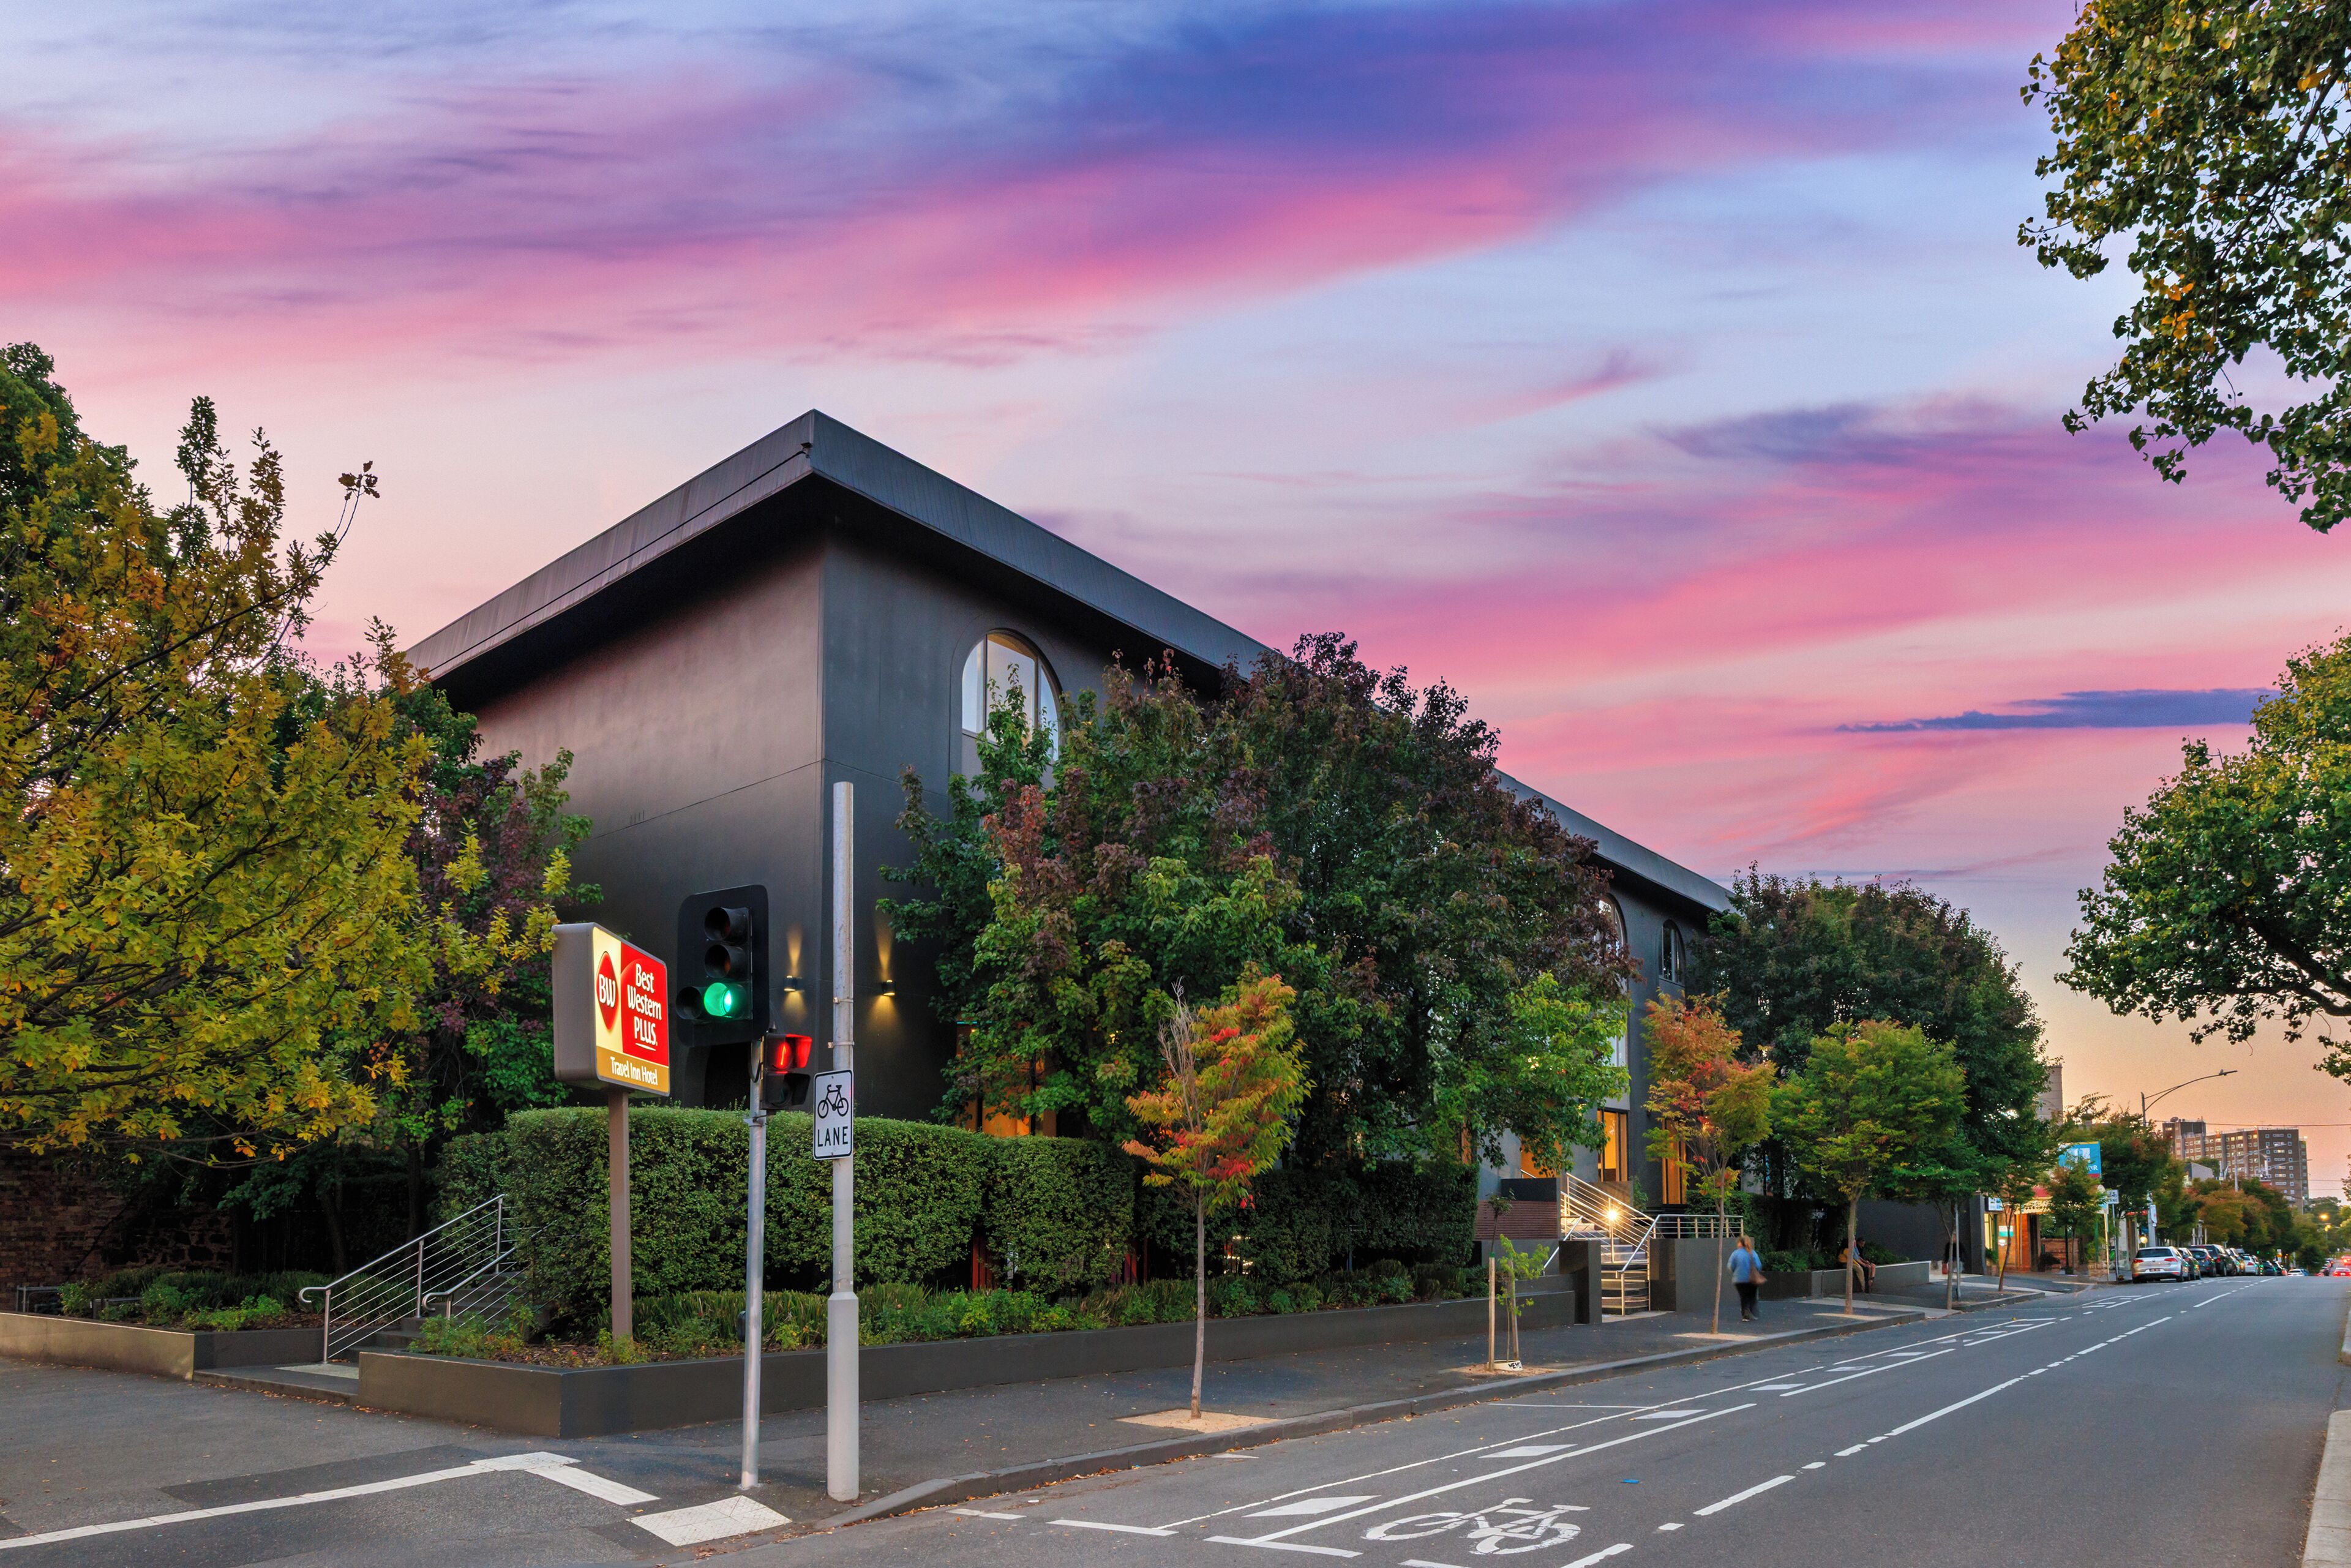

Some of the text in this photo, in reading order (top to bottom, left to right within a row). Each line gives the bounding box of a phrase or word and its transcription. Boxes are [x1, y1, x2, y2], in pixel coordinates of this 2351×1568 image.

[598, 973, 616, 1008] BW
[636, 963, 654, 994] Best
[627, 985, 662, 1021] Western
[634, 1016, 656, 1046] PLUS
[610, 1056, 658, 1086] Travel Inn Hotel
[817, 1126, 849, 1147] LANE
